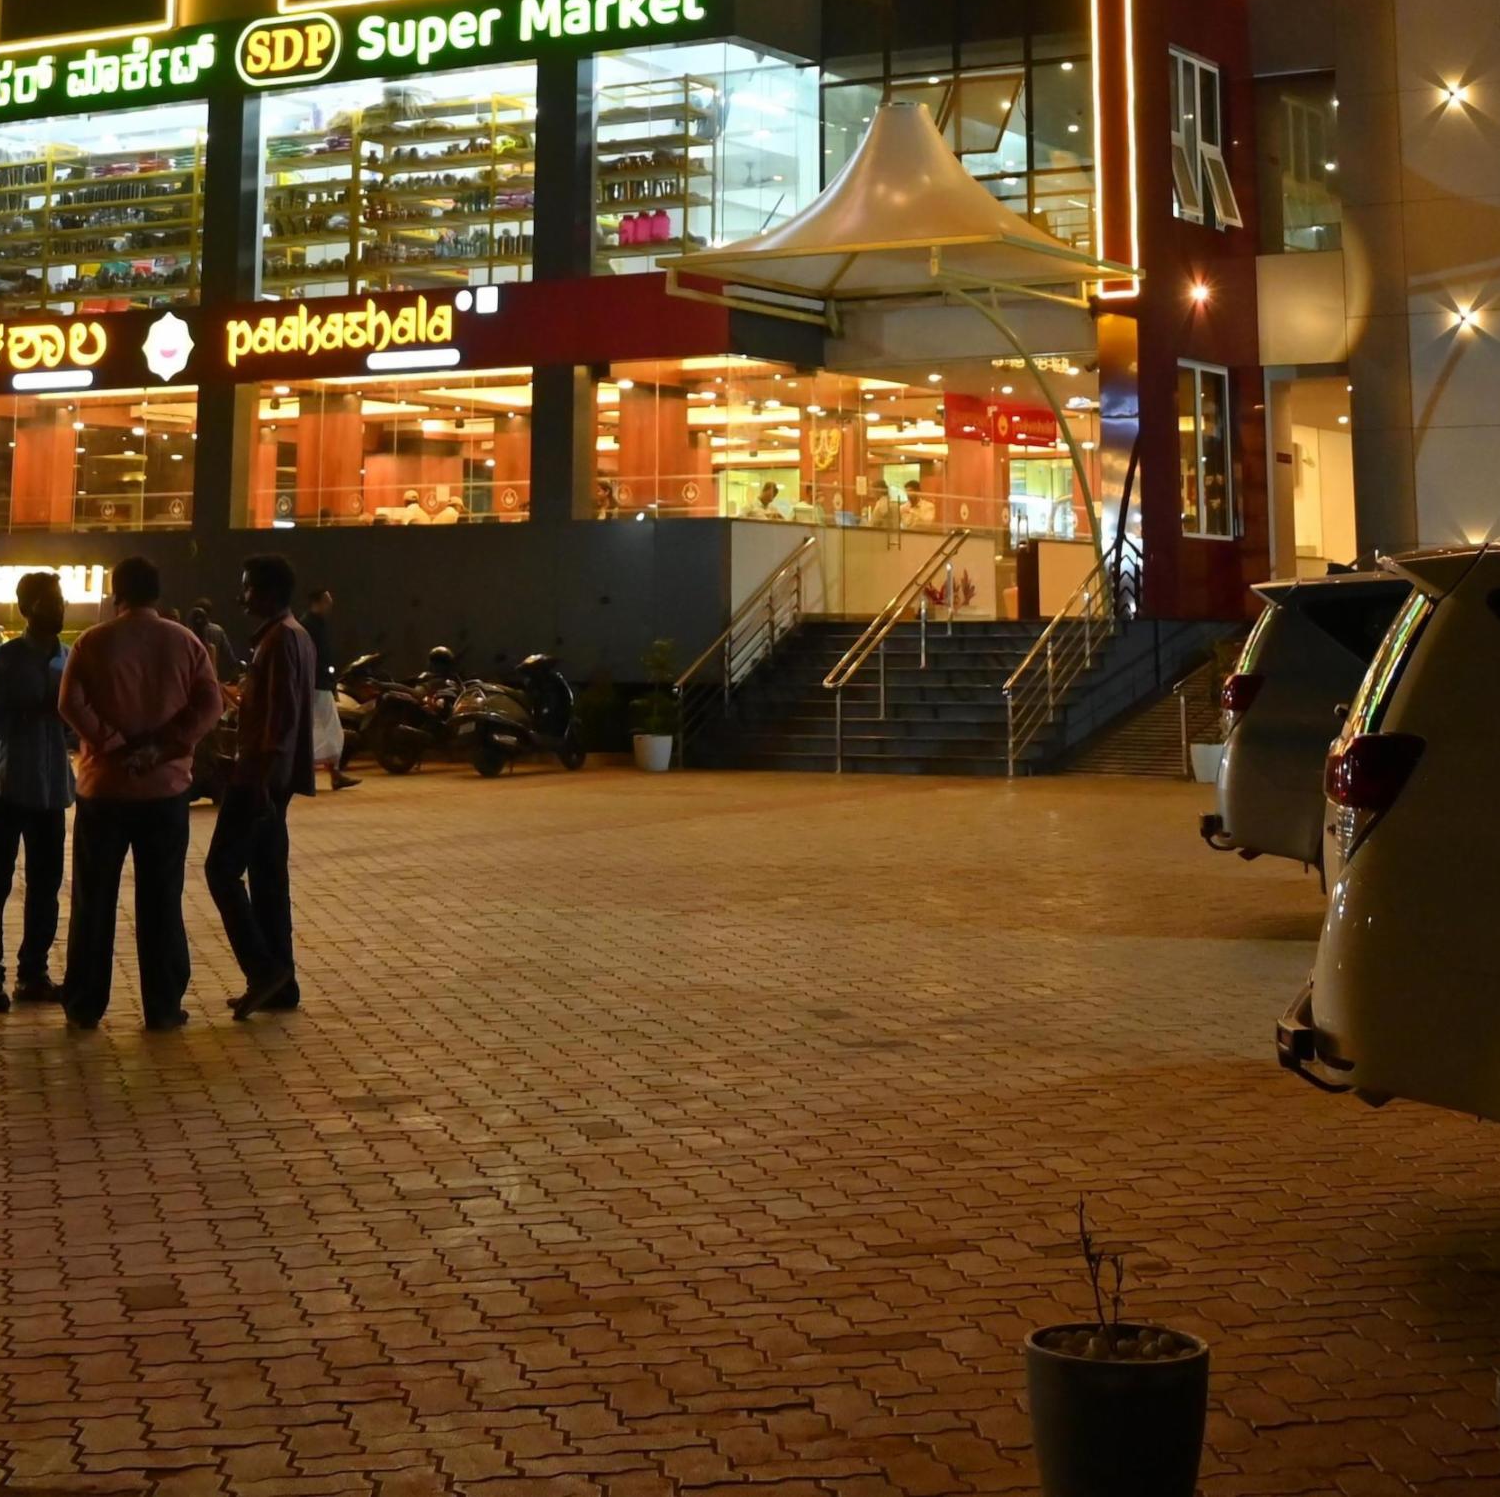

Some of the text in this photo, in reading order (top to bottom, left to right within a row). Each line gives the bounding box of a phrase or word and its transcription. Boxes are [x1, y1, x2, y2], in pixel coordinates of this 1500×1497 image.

[67, 33, 216, 98] ಮಾರ್ಕೆಟ್
[246, 23, 331, 74] SDP
[357, 8, 501, 64] Super
[226, 294, 453, 367] paakashala
